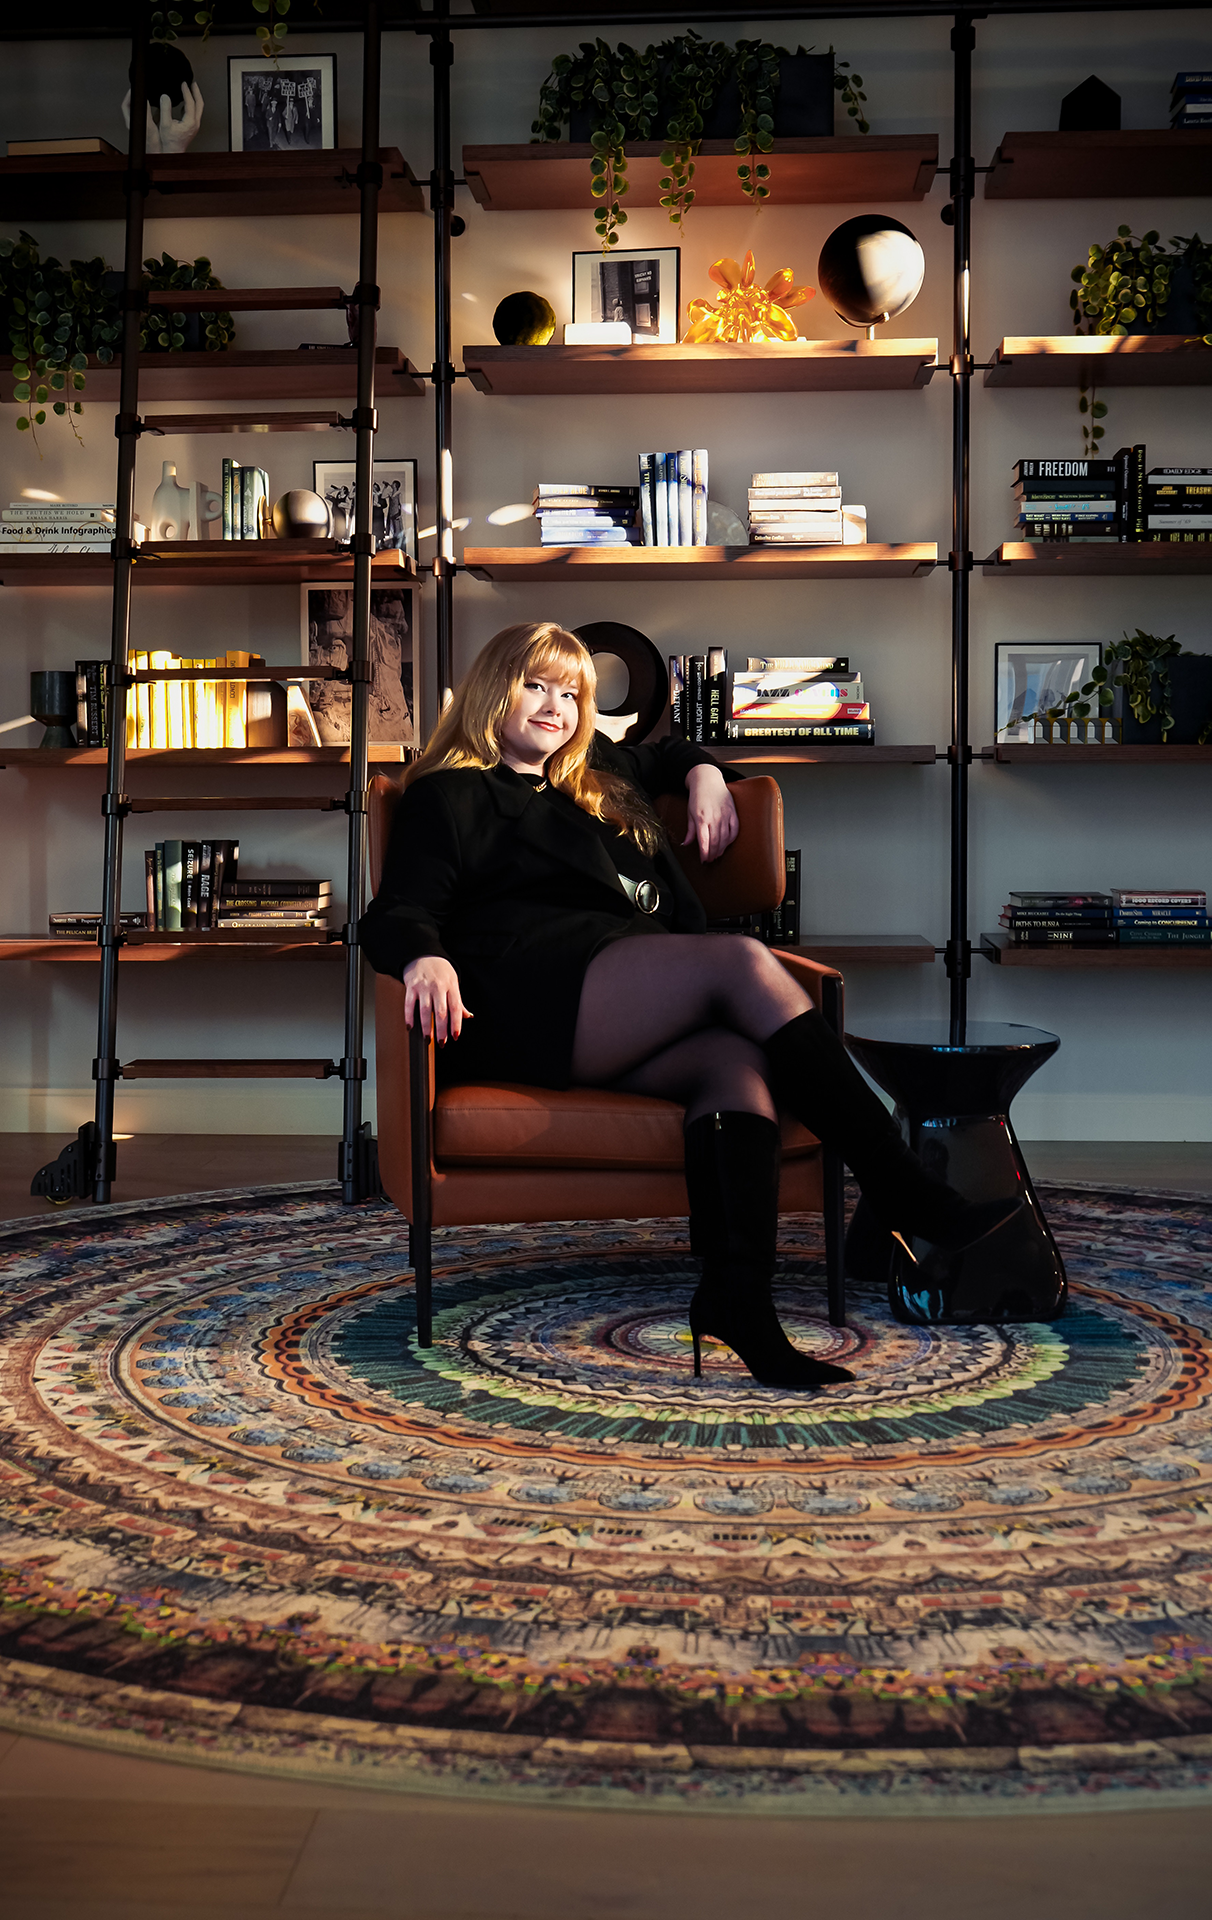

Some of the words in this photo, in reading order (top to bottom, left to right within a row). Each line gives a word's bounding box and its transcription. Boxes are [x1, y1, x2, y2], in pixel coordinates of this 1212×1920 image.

[1039, 462, 1088, 476] FREEDOM
[2, 527, 23, 535] Food
[35, 526, 59, 535] Drink
[62, 526, 116, 538] Infographics
[711, 690, 719, 706] HELL
[710, 708, 719, 724] GATE
[744, 728, 796, 736] GREATEST
[799, 727, 812, 736] OF
[814, 728, 832, 736] ALL
[834, 727, 859, 736] TIME
[201, 874, 210, 898] RAGE
